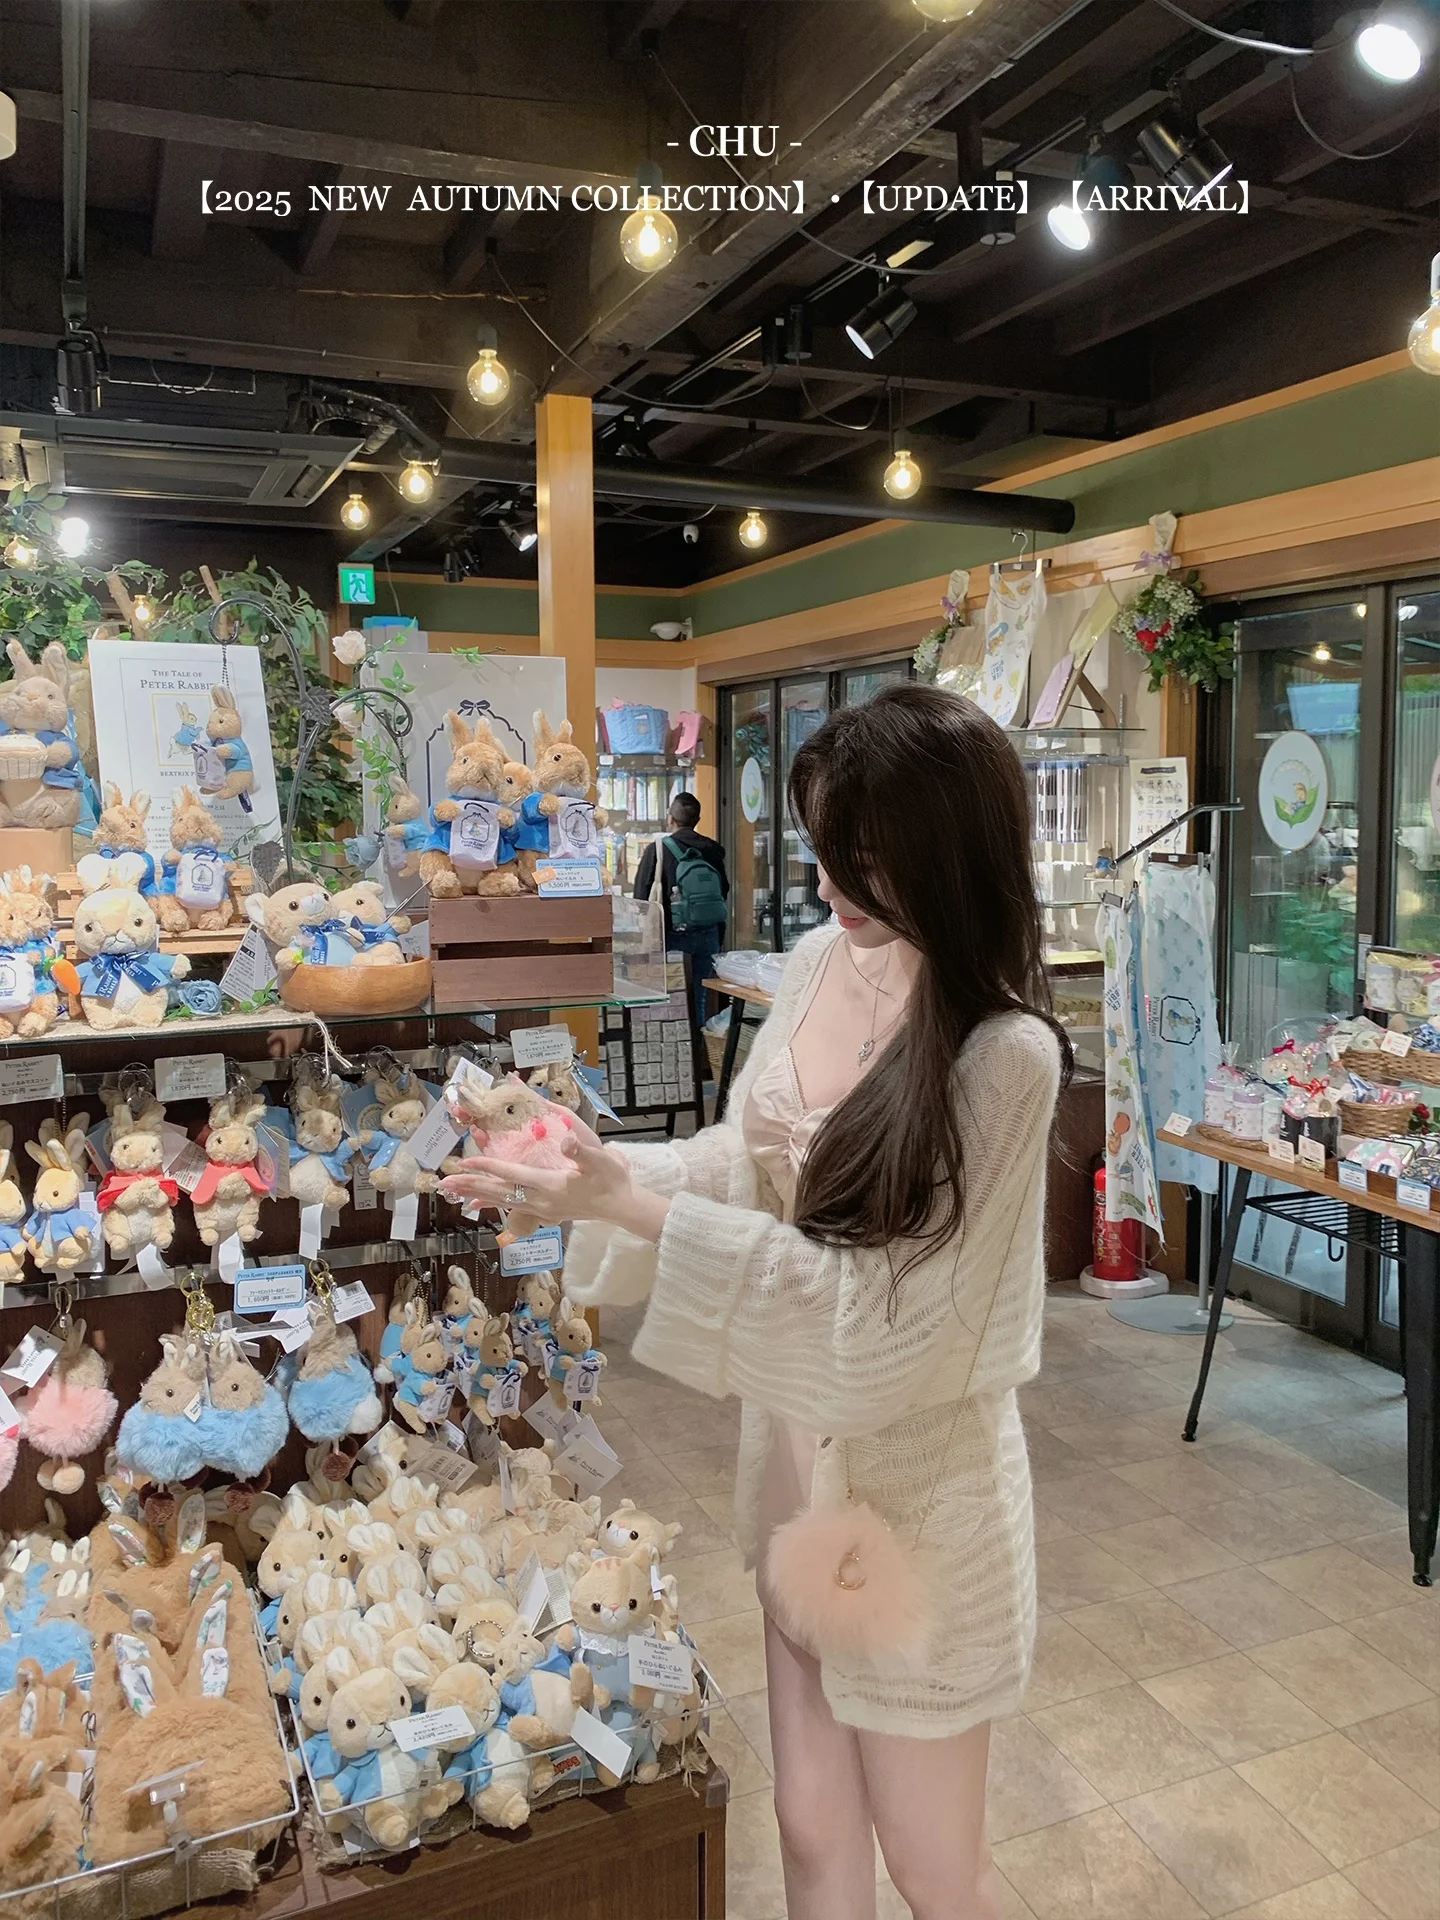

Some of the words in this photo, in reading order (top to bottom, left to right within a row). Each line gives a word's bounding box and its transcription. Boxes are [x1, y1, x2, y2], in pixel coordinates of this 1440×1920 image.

[152, 669, 170, 677] THE
[171, 670, 191, 678] TALE
[140, 679, 175, 690] PETER
[177, 680, 214, 691] RABBI
